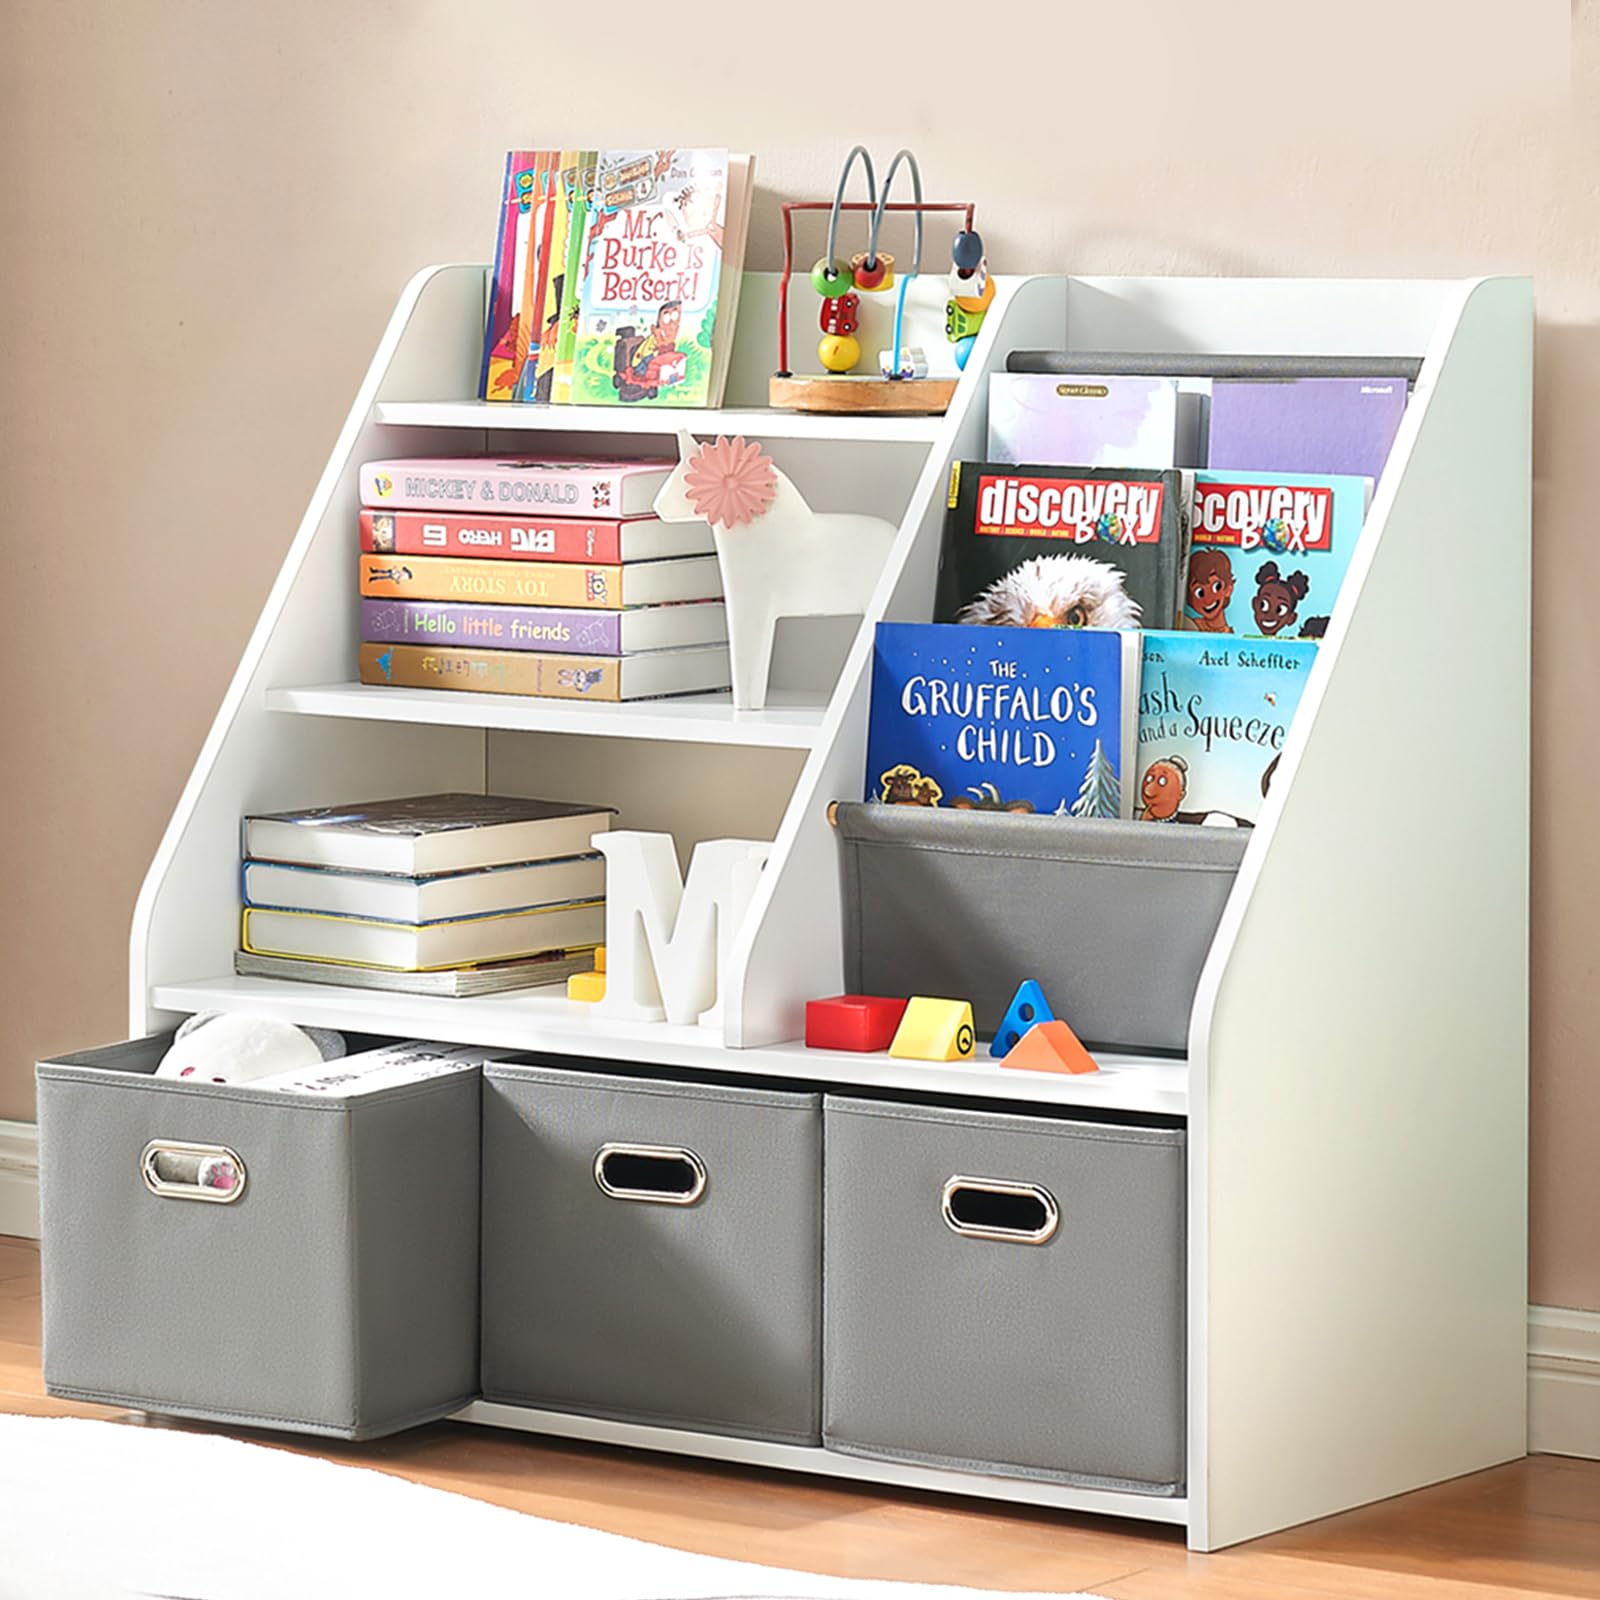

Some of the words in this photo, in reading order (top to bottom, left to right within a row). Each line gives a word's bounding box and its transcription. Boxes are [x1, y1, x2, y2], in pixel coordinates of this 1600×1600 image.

[622, 208, 663, 240] Mr.
[601, 238, 677, 273] Burke
[686, 243, 704, 270] Is
[601, 271, 699, 303] Berserk!
[405, 476, 477, 501] MICKEY
[479, 480, 495, 502] &
[498, 481, 579, 505] DONALD
[980, 479, 1159, 537] discovery
[1192, 487, 1328, 543] scovery
[457, 528, 503, 546] HERO
[510, 527, 556, 553] BIG
[448, 576, 506, 595] STORY
[513, 579, 549, 598] TOY
[414, 612, 457, 635] Hello
[462, 615, 503, 638] little
[509, 617, 571, 642] friends
[989, 659, 1018, 680] THE
[1198, 650, 1230, 667] Axel
[1237, 650, 1301, 670] Scheffler
[901, 675, 1098, 727] GRUFFALO'S
[1139, 671, 1183, 717] ash
[1139, 717, 1165, 744] and
[1168, 722, 1178, 738] a
[1184, 694, 1286, 752] Squeeze
[956, 723, 1056, 767] CHILD
